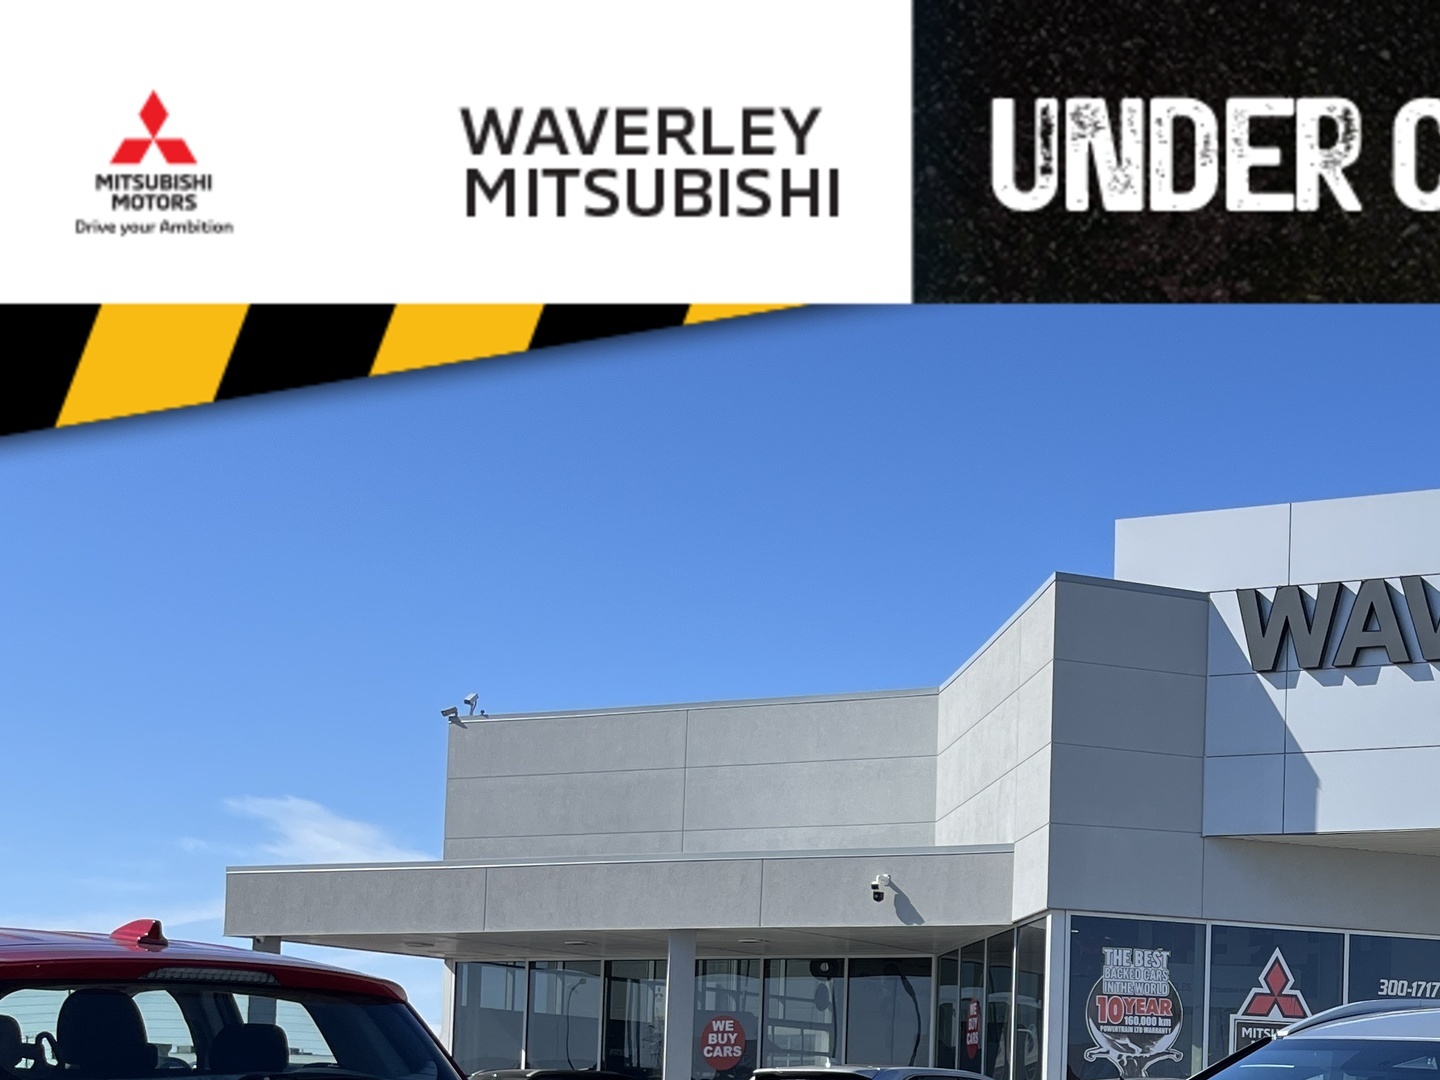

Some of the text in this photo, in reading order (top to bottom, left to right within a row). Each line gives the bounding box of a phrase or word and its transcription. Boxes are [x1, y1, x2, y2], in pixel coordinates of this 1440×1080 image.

[1102, 947, 1171, 968] THE BEST
[1104, 967, 1169, 981] BACKED CARS
[1103, 981, 1115, 994] IN
[1115, 982, 1134, 995] THE
[1134, 982, 1169, 996] WORLD
[1378, 979, 1440, 998] 300-1717
[1096, 996, 1173, 1024] 10 YEAR
[712, 1020, 734, 1031] WE
[968, 1017, 978, 1030] BUY
[1124, 1016, 1171, 1027] 160,000 km
[708, 1033, 738, 1044] BUY
[966, 1032, 979, 1045] CARS
[703, 1045, 742, 1057] CARS
